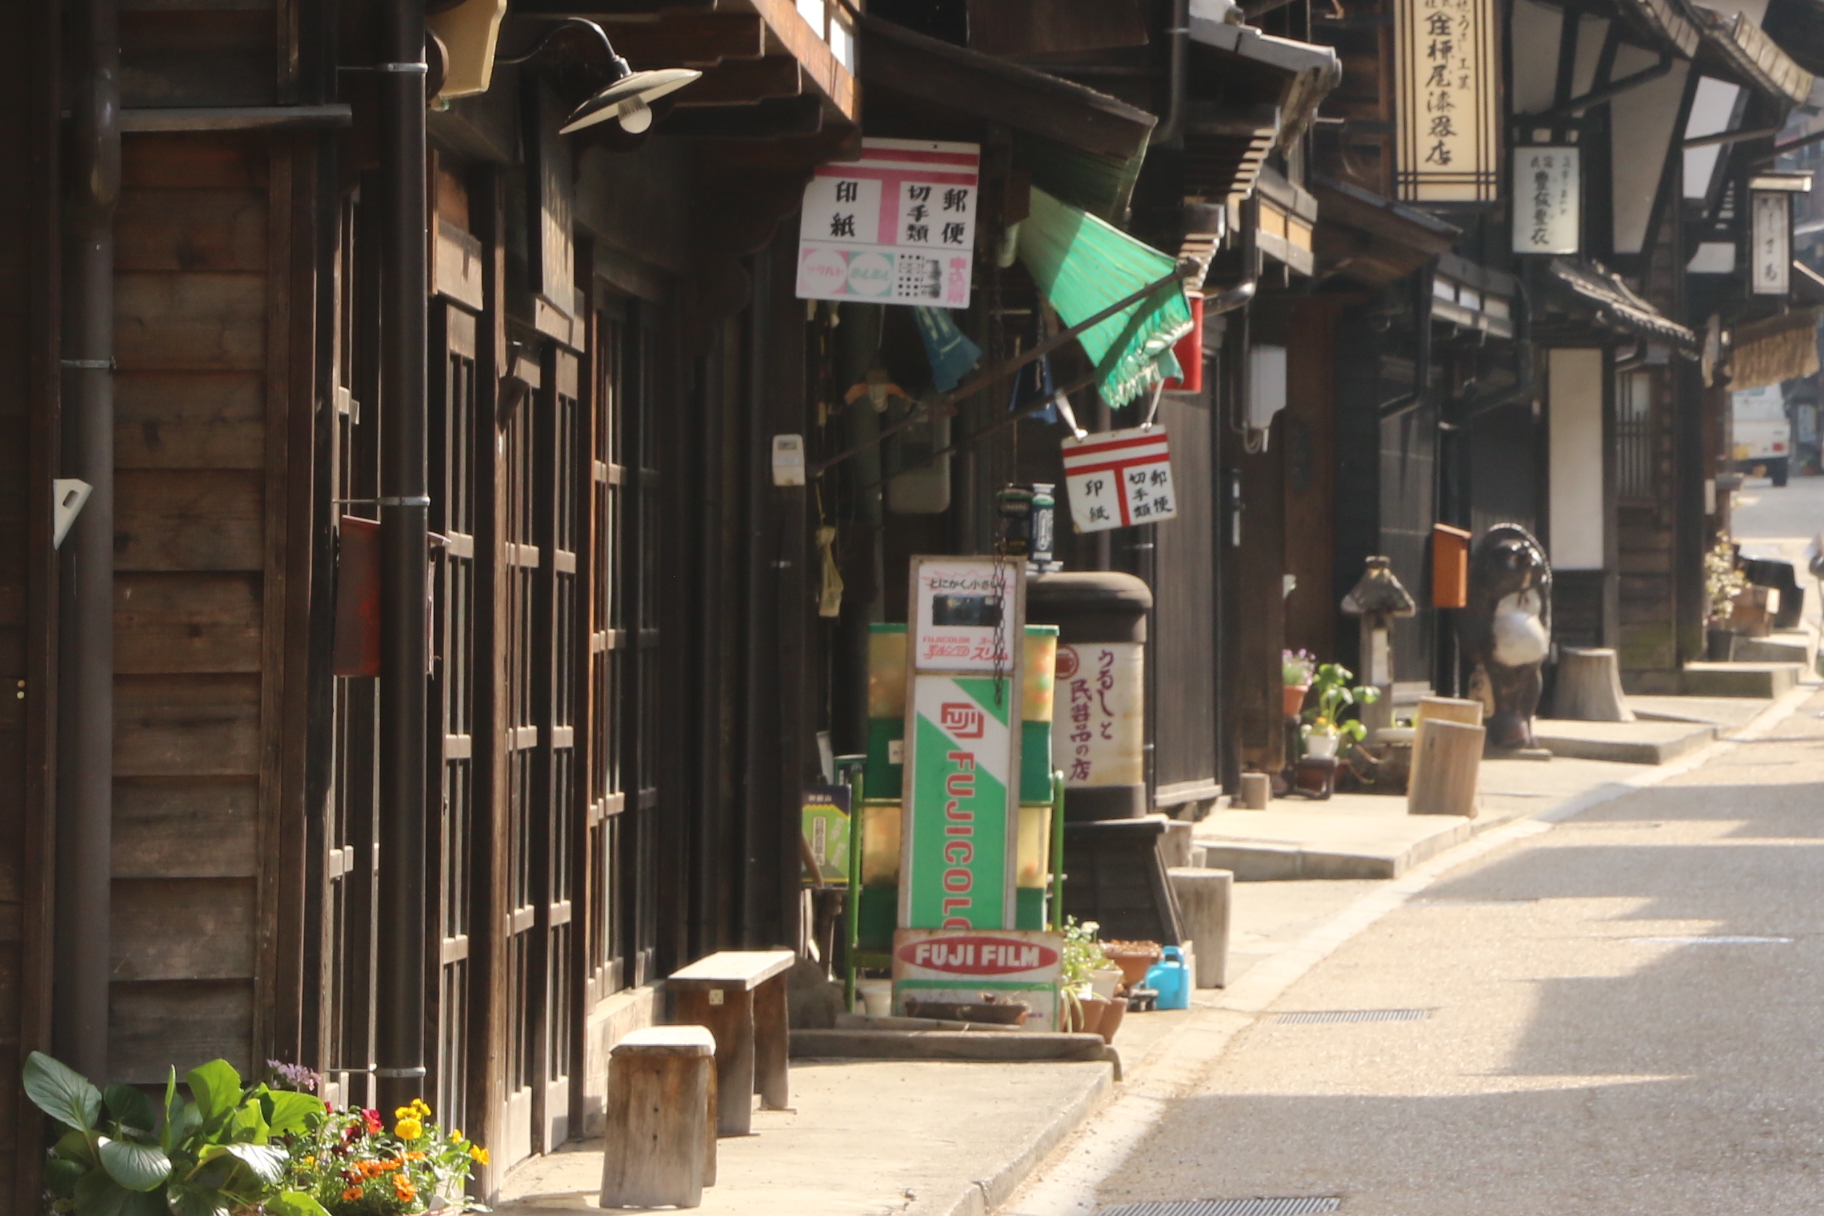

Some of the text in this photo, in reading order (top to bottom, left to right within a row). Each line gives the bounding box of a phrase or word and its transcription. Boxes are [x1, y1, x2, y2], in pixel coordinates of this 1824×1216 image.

[830, 180, 858, 237] 印紙
[906, 185, 931, 243] 切手類
[940, 187, 968, 245] 郵便
[1085, 478, 1110, 522] 印紙
[1128, 471, 1153, 519] 切手類
[1149, 469, 1174, 515] 郵便
[923, 636, 971, 645] FUJICOLOR
[1096, 649, 1116, 740] うるしと
[915, 943, 1040, 967] FUJI FILM
